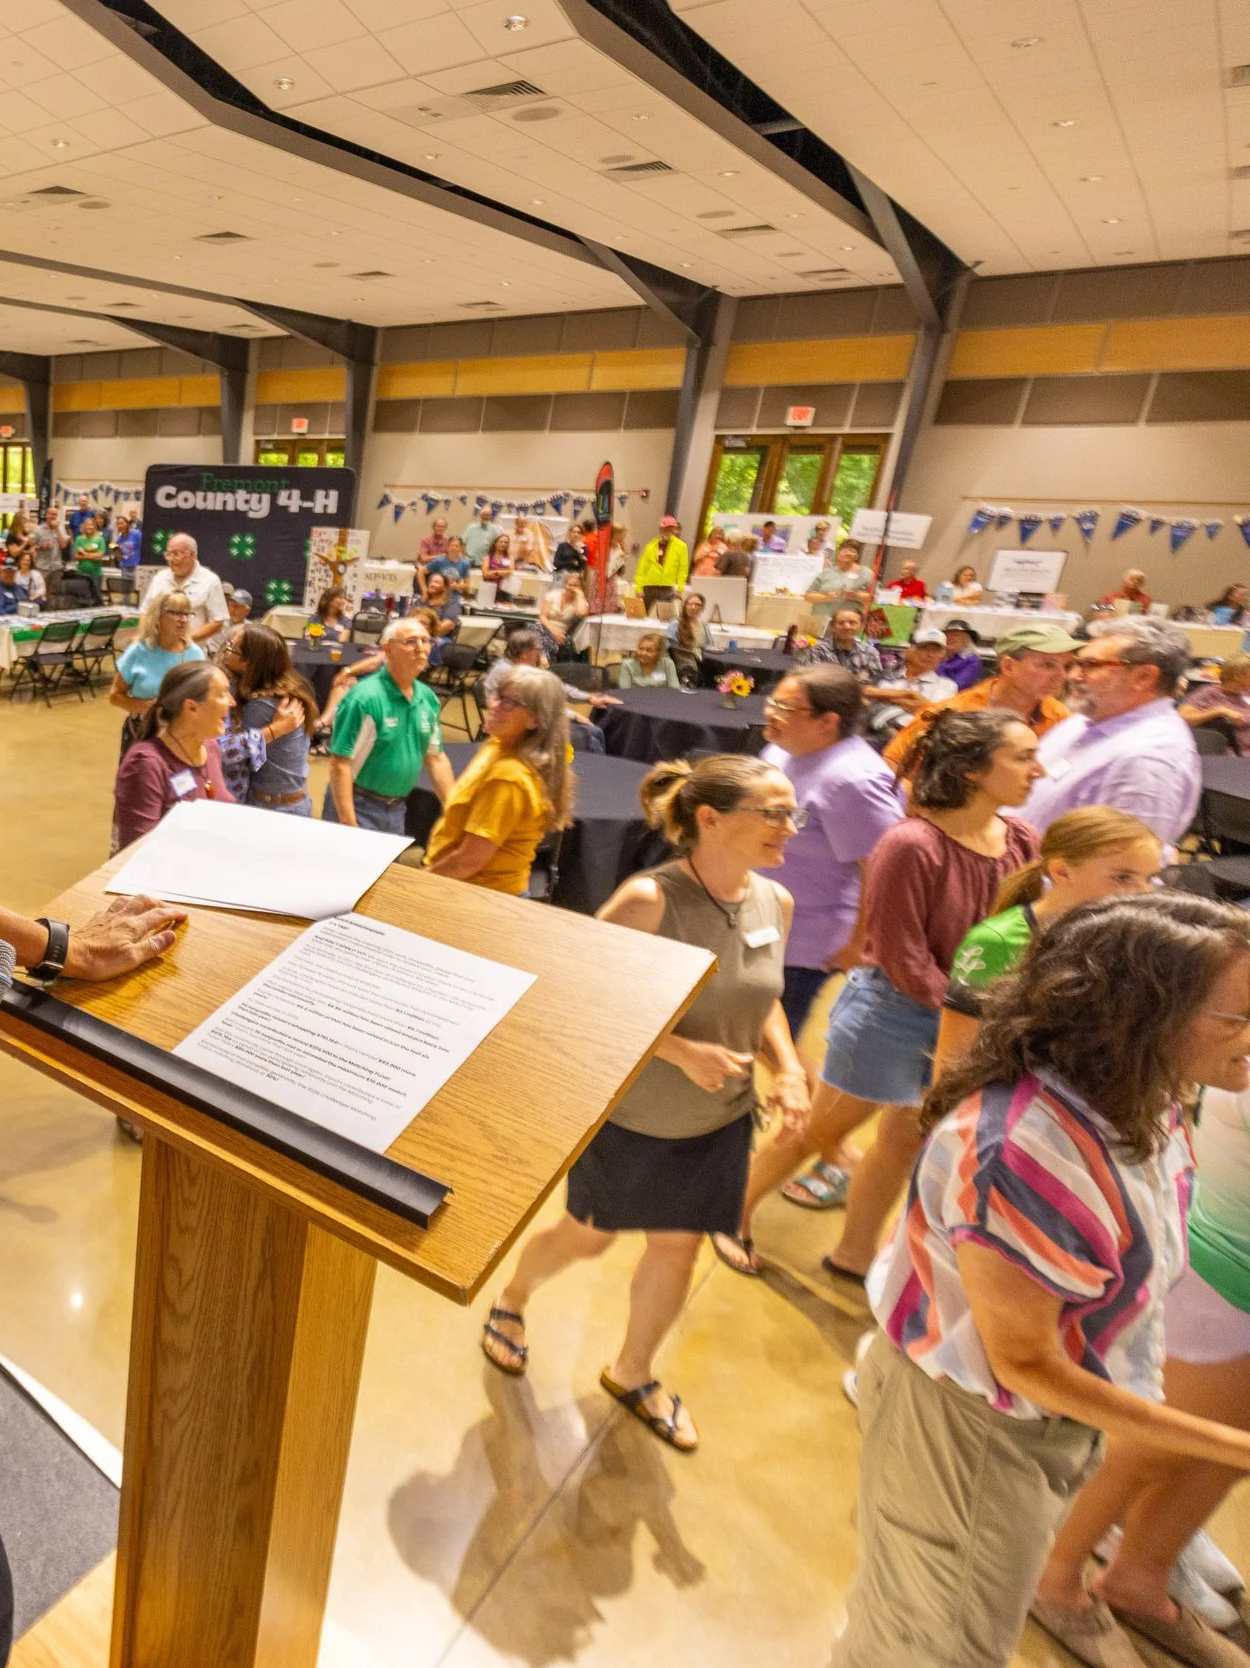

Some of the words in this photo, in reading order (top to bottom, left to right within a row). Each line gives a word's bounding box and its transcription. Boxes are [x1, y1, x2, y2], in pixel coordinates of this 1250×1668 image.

[201, 472, 289, 493] Fremont
[155, 484, 271, 519] County
[276, 488, 340, 514] 4-H
